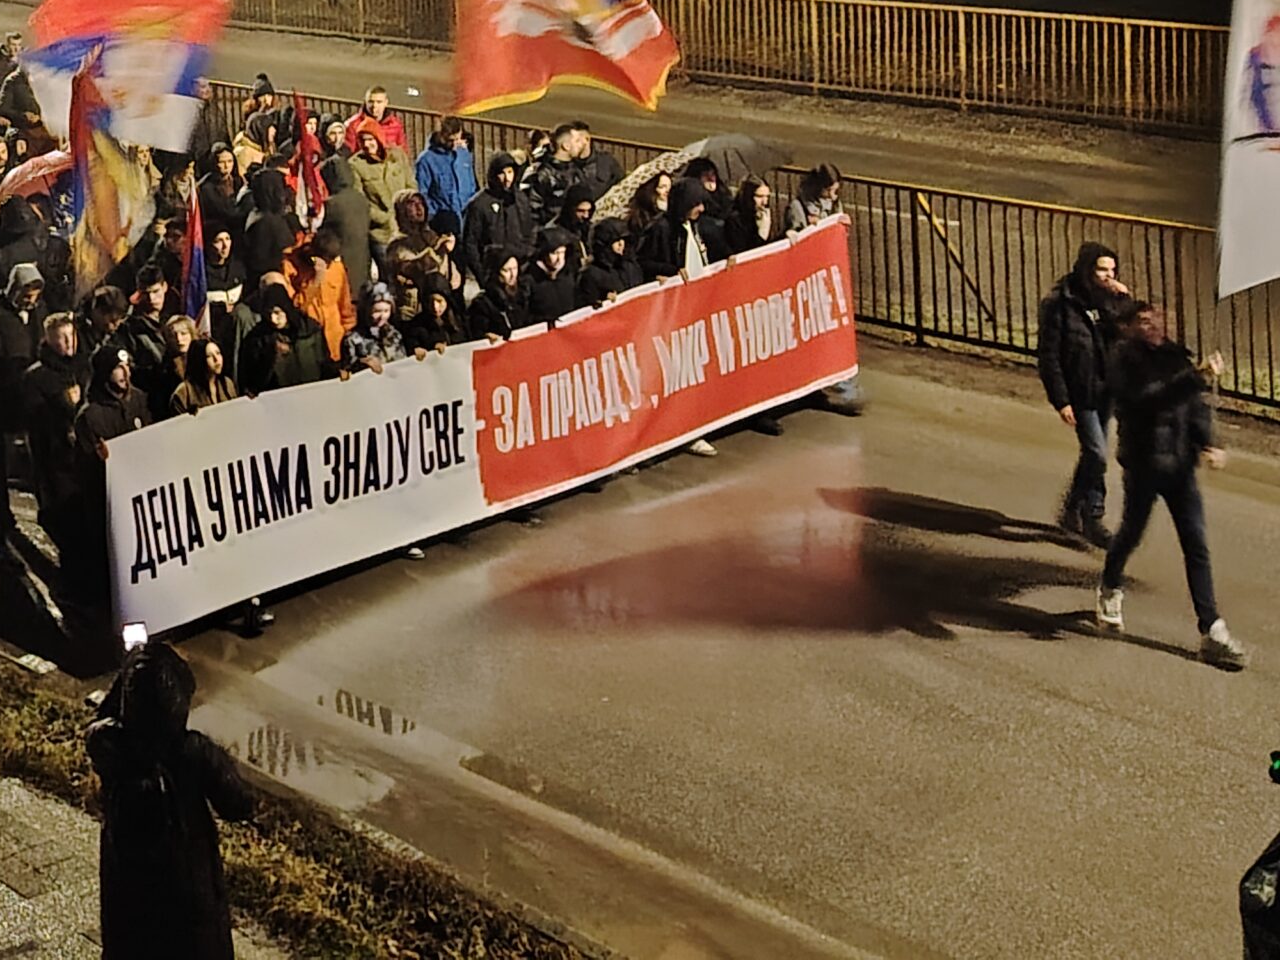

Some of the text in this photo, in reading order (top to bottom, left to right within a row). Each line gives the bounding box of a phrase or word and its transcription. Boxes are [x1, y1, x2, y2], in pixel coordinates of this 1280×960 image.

[130, 476, 205, 585] ДЕЦА
[202, 466, 227, 542] У
[227, 443, 313, 535] НАМА
[323, 415, 411, 505] ЗНАЈУ
[418, 399, 466, 476] СВЕ
[491, 381, 536, 454] ЗА
[652, 319, 710, 399] МИР
[710, 310, 736, 376] И
[734, 287, 798, 368] НОВЕ
